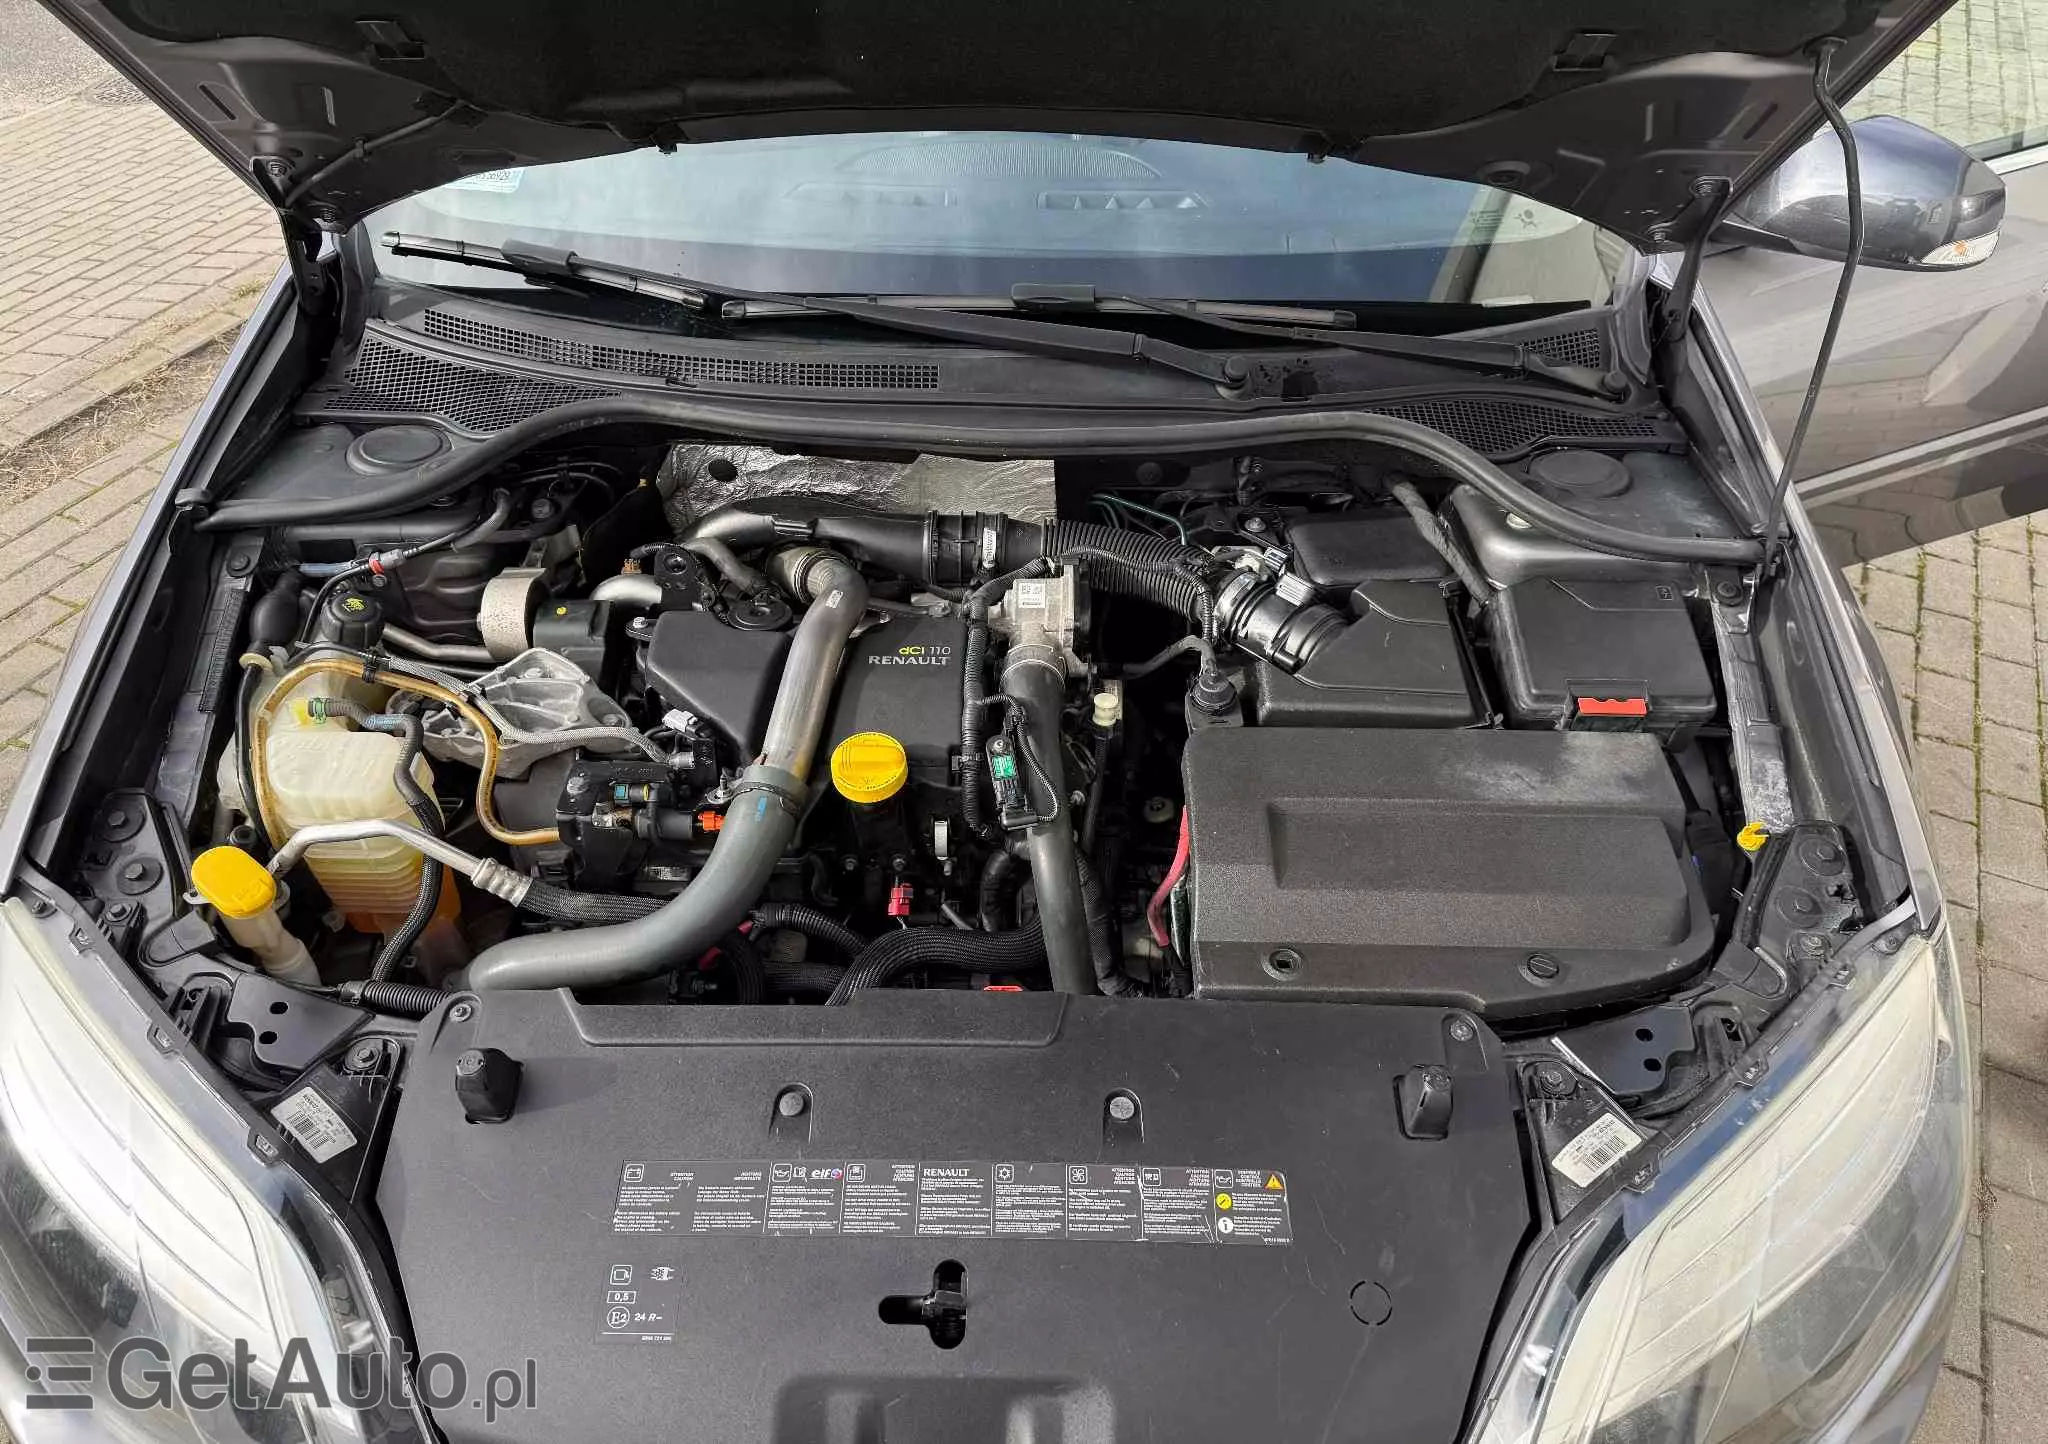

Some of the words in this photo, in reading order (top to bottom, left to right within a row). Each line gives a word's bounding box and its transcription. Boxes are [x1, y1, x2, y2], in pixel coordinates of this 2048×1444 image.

[929, 646, 951, 655] 110
[868, 655, 951, 665] RENAULT
[811, 1168, 832, 1178] elf
[923, 1168, 970, 1177] RENAULT
[614, 1293, 629, 1302] 0,5
[634, 1313, 646, 1321] 24
